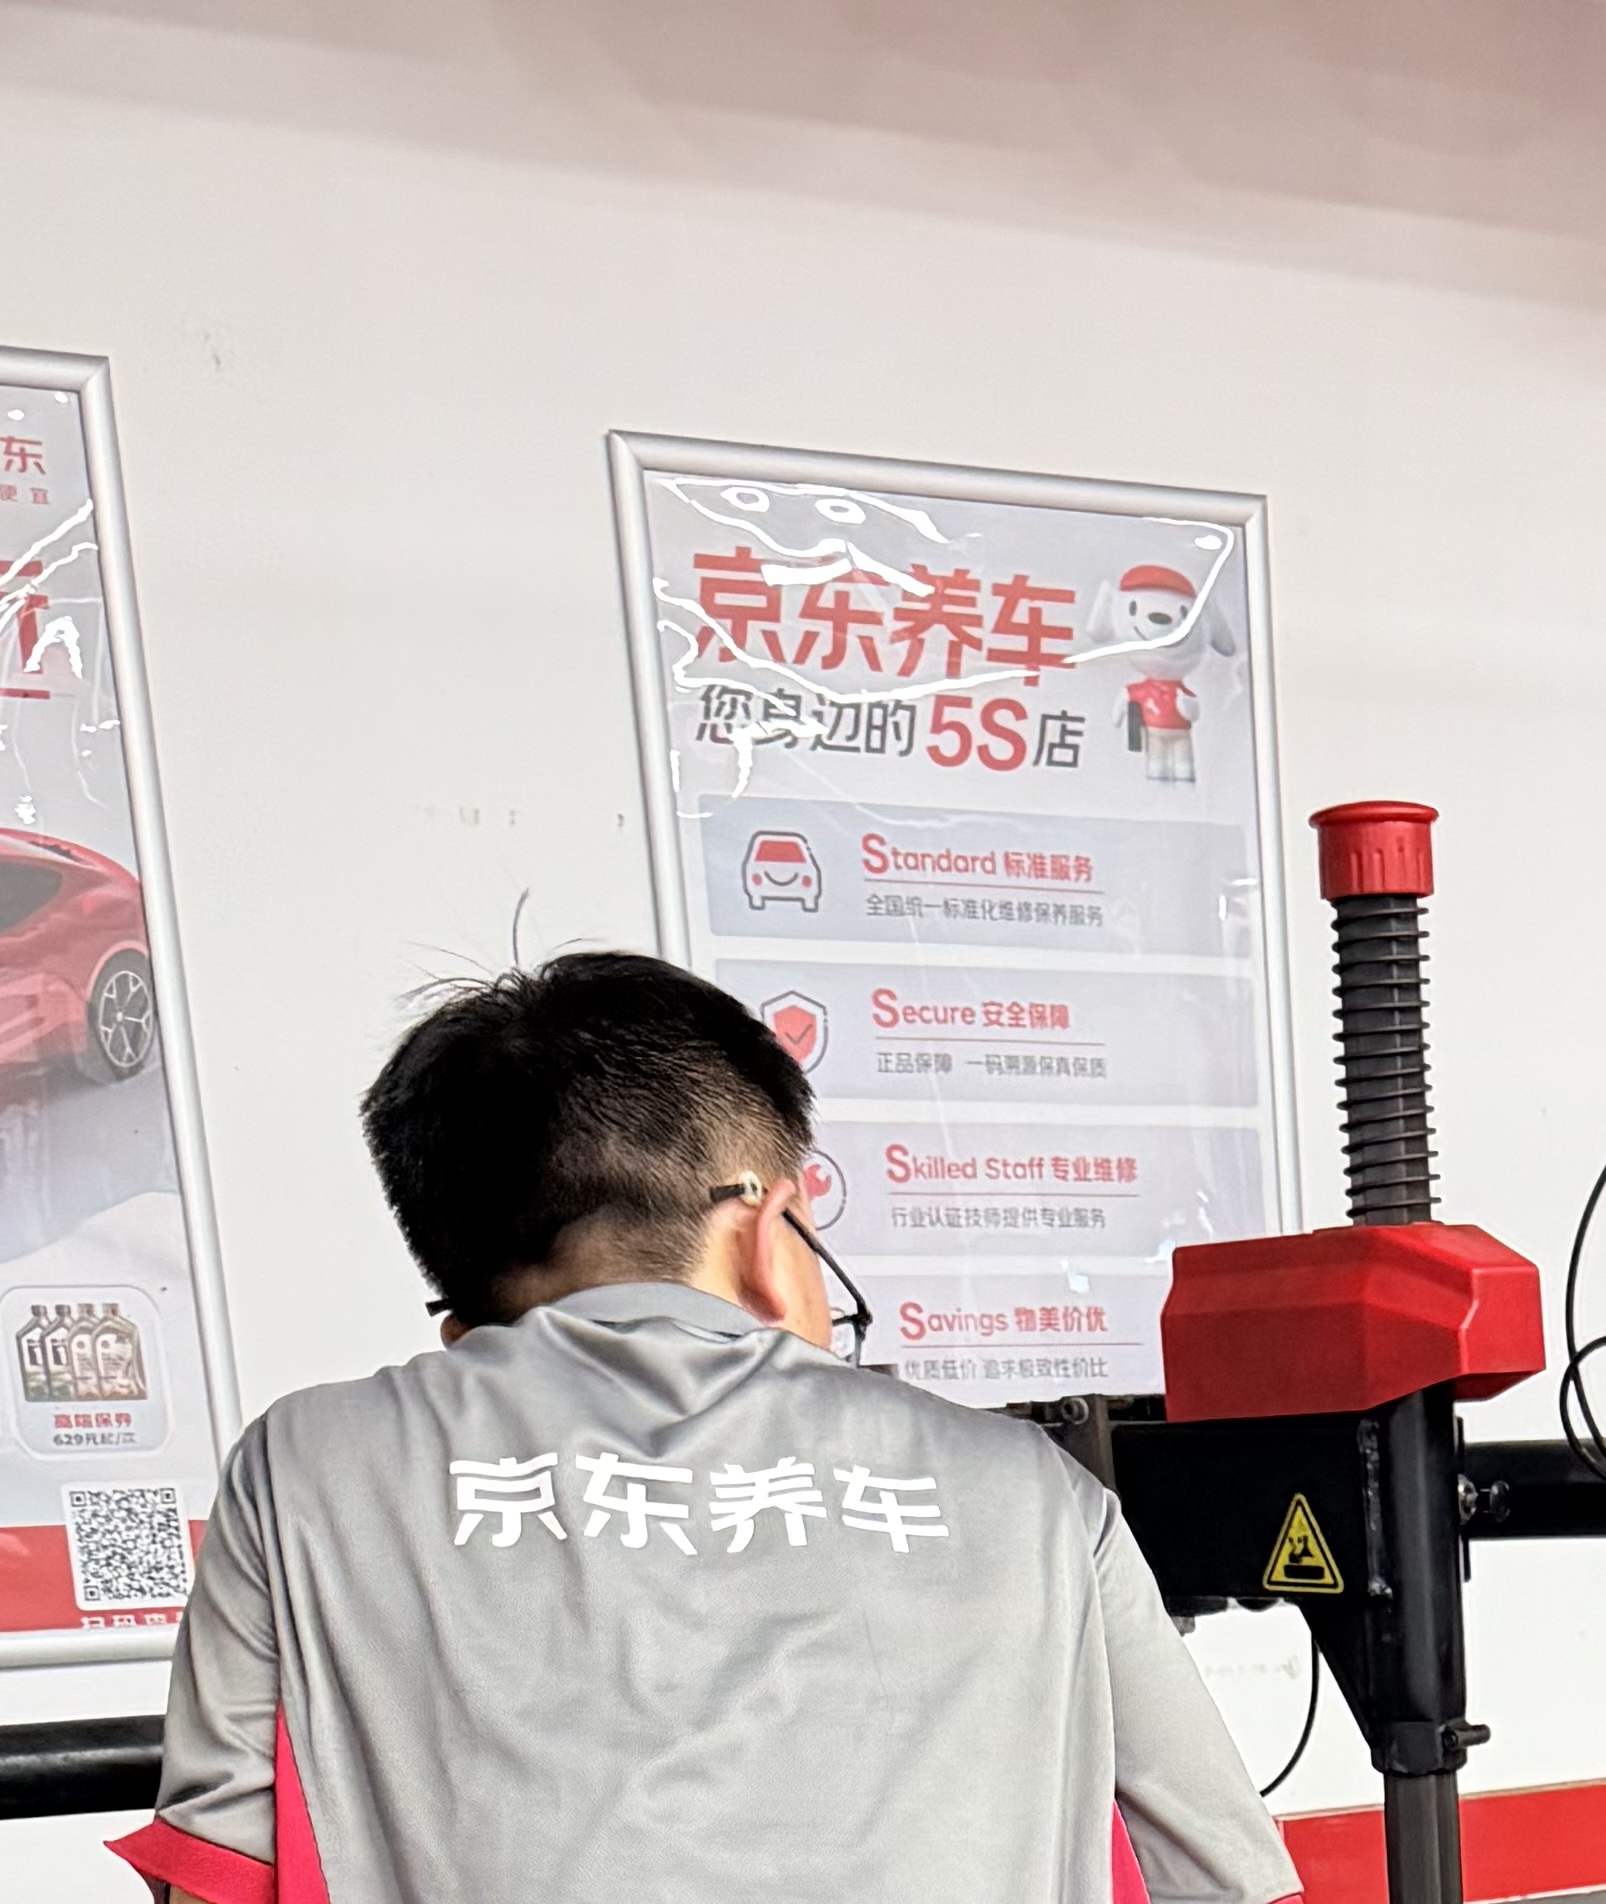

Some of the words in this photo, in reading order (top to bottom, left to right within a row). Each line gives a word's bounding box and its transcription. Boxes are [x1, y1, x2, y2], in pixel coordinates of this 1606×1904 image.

[692, 546, 1077, 688] 京东养车
[695, 682, 1085, 773] 您身边的5S店
[861, 833, 997, 878] Standard
[1003, 850, 1094, 884] 标准服务
[871, 987, 976, 1029] Secure
[982, 1000, 1070, 1030] 安全保障
[885, 1143, 977, 1184] Skilled
[985, 1156, 1044, 1181] Staff
[1051, 1156, 1138, 1183] 专业维修
[899, 1301, 1009, 1340] Savings
[449, 1452, 950, 1556] 京东养车
